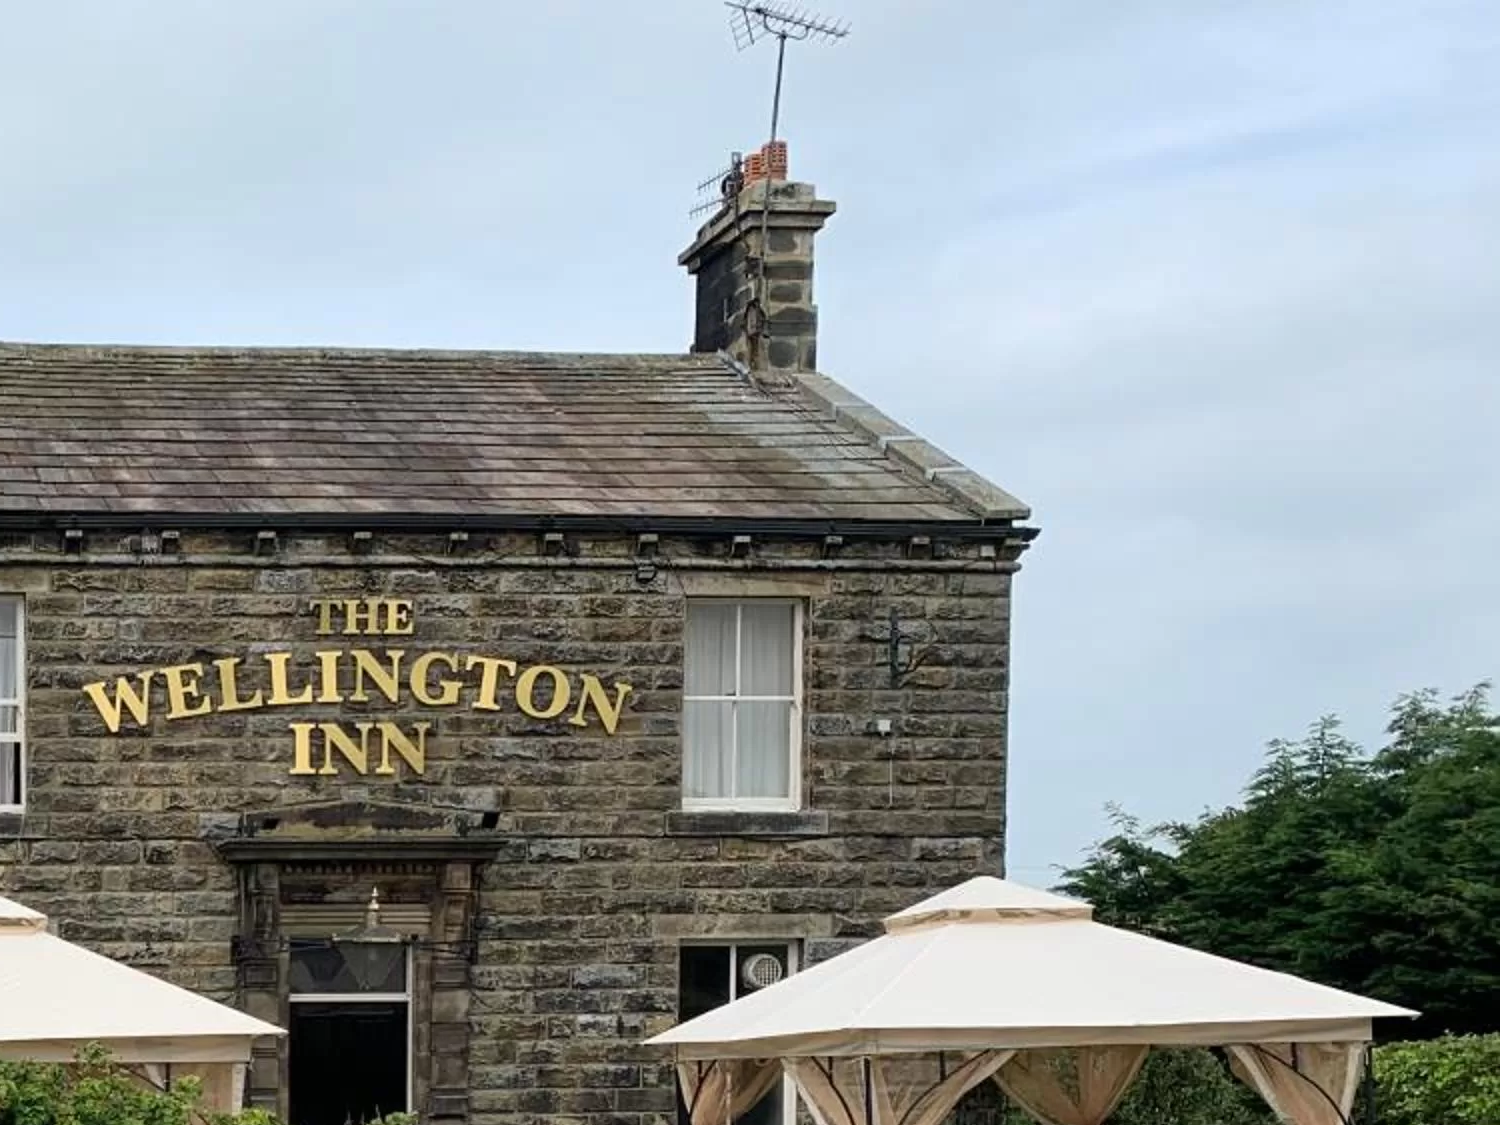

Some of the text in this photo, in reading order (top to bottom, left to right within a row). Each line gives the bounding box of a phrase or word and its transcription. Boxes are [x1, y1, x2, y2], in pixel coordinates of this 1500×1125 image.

[309, 599, 414, 635] THE
[82, 650, 633, 735] WELLINGTON
[288, 721, 432, 775] INN
